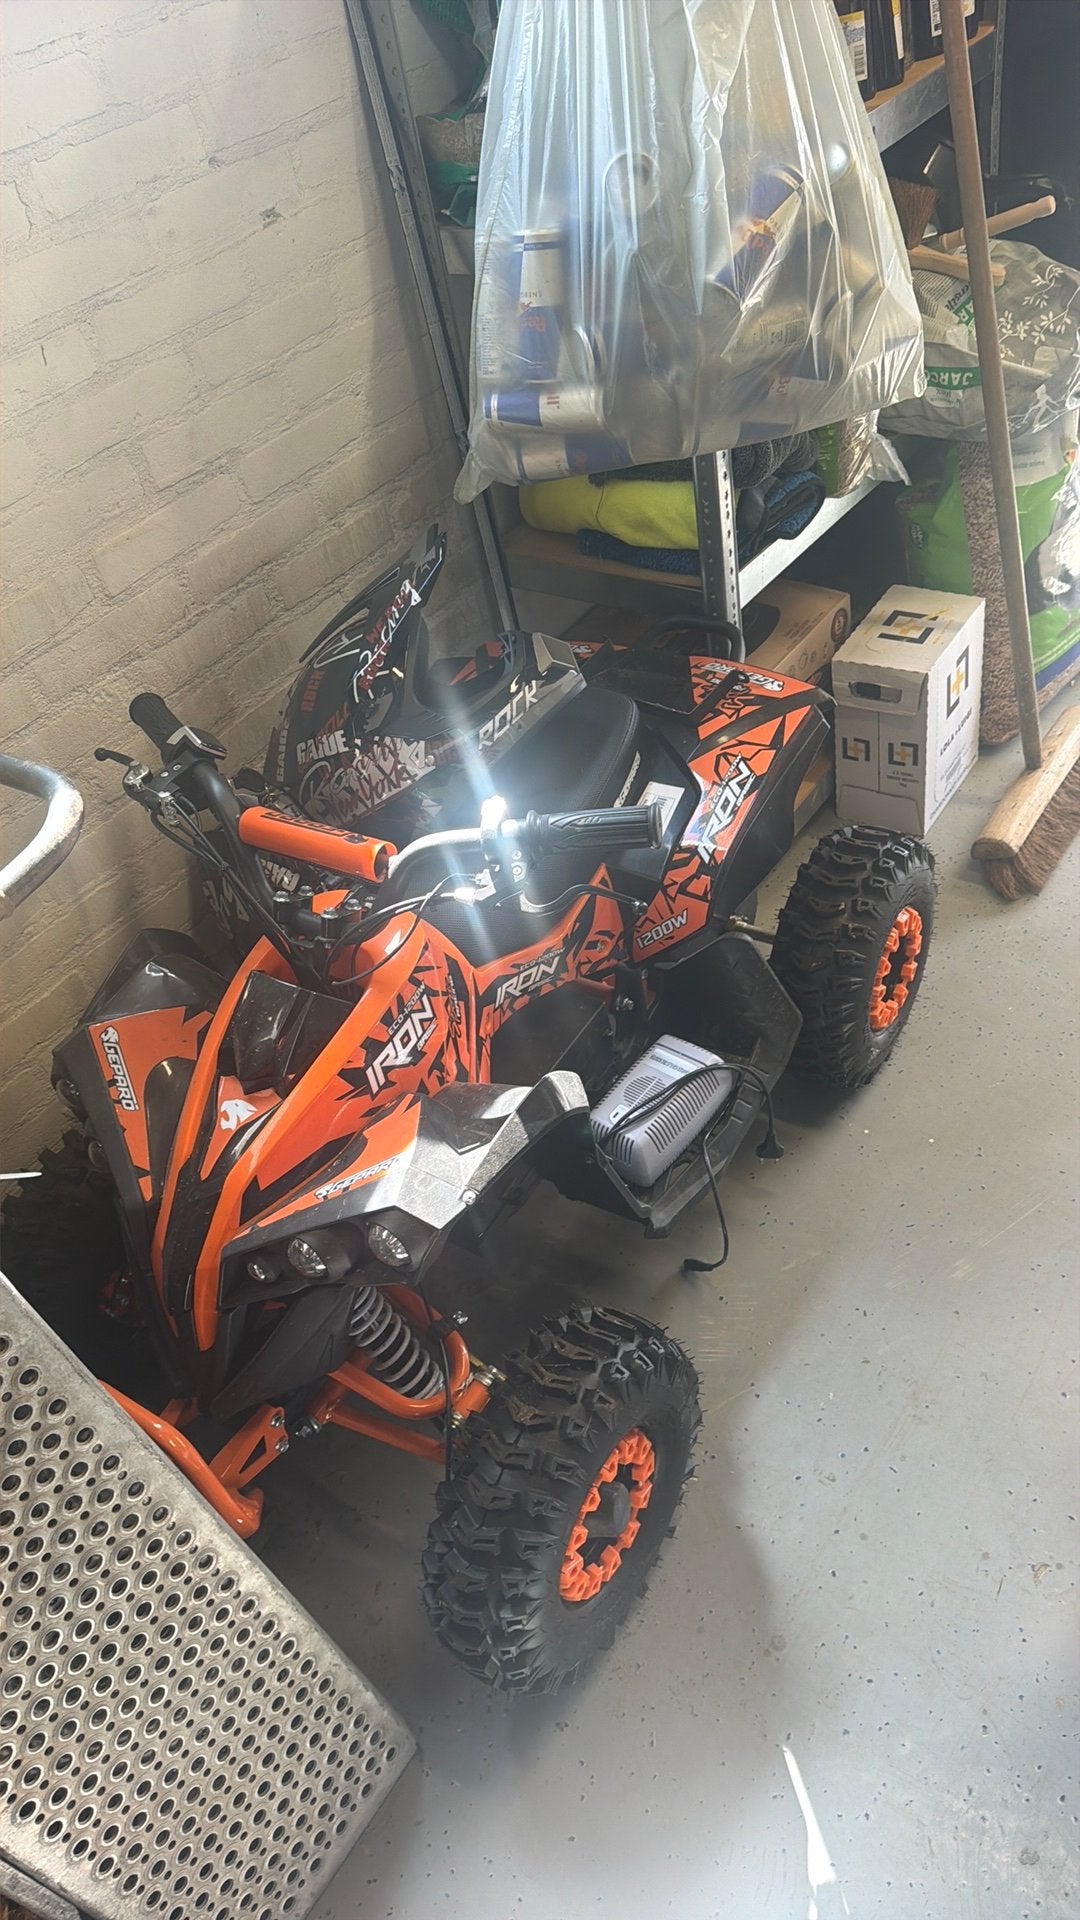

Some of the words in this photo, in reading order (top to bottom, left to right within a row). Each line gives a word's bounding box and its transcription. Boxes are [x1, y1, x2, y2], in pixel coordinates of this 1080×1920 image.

[479, 680, 539, 751] ROCK
[697, 760, 752, 864] IRON
[636, 909, 688, 949] 1200W
[388, 981, 426, 1036] ECO-1200W
[495, 956, 560, 1009] IRON
[103, 1042, 139, 1110] GEPARD
[366, 994, 434, 1095] IRON
